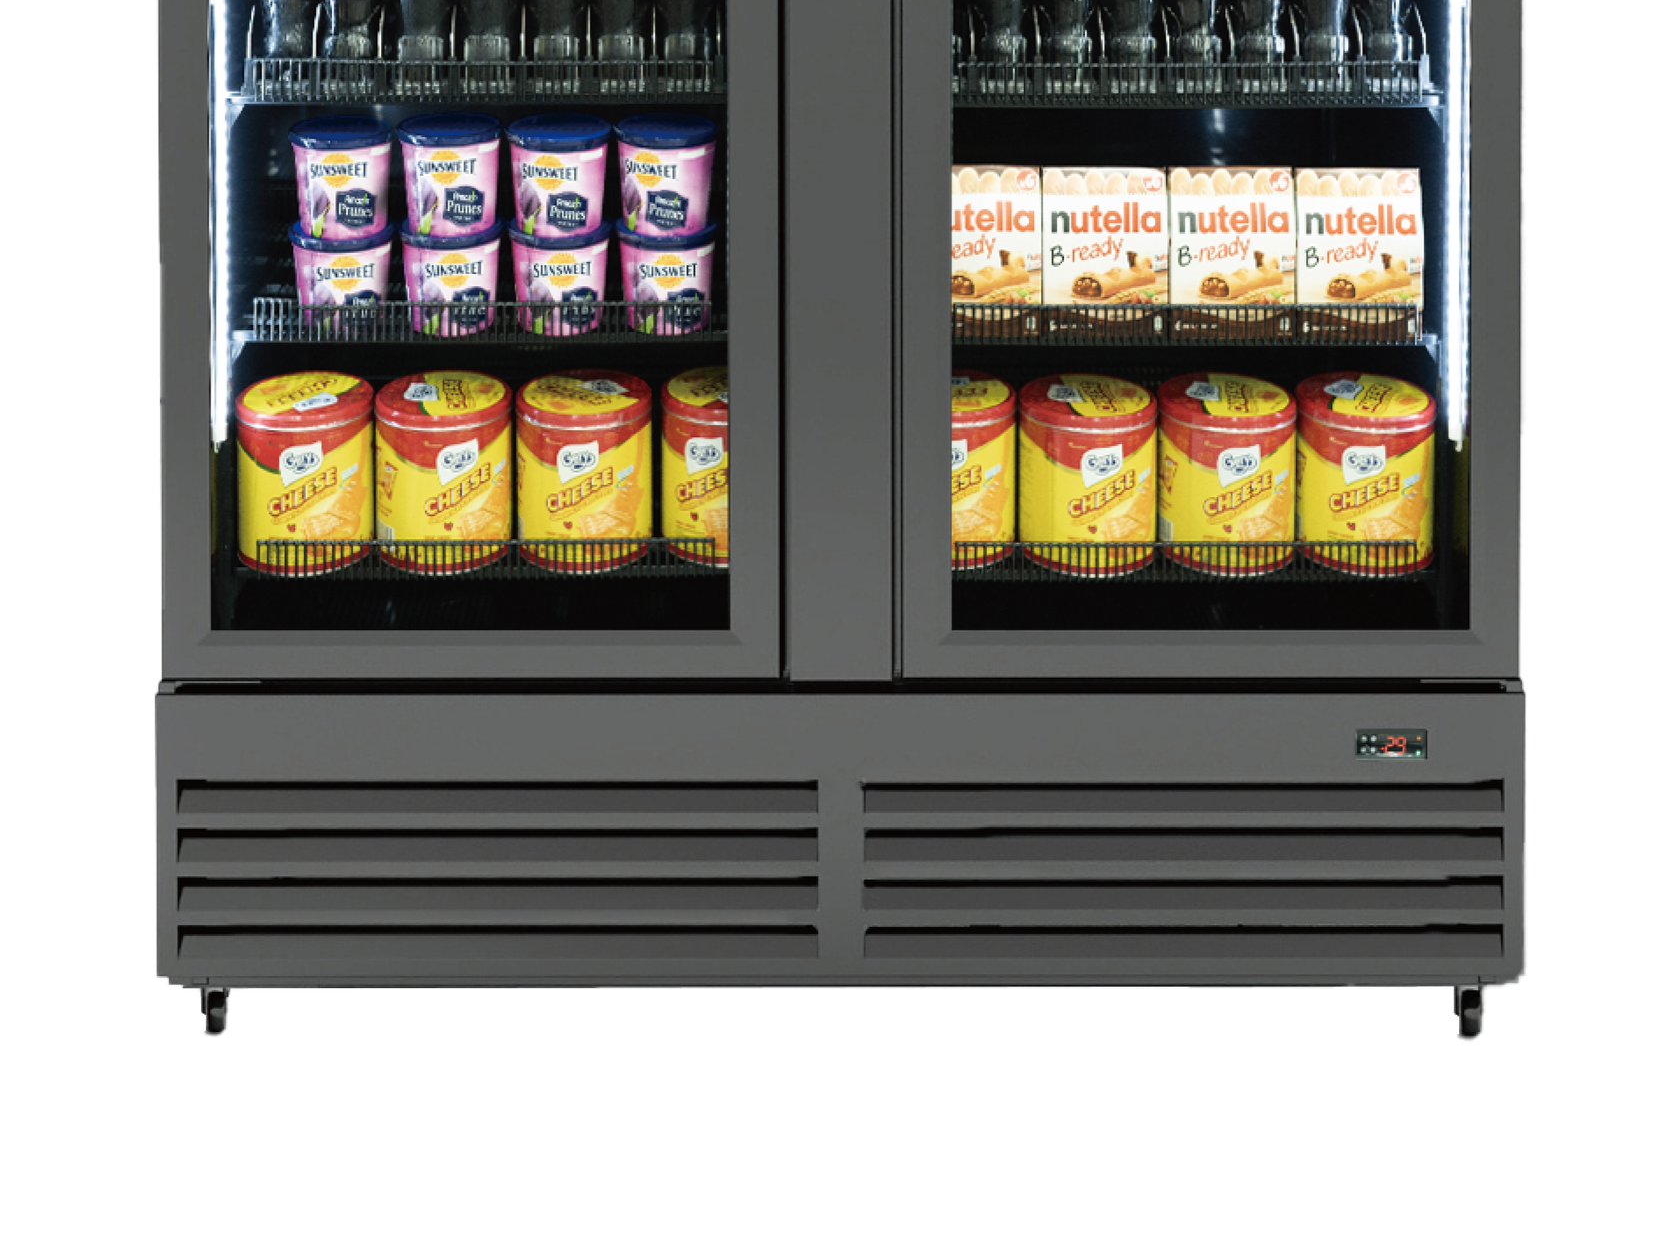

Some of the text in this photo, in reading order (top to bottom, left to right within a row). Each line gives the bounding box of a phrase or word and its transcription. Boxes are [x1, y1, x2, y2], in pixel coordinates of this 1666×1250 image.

[310, 161, 367, 179] SUNSWEET
[417, 157, 477, 176] SUNSWEET
[522, 162, 578, 181] SUNSWEET
[624, 157, 678, 180] SUNSWEET
[338, 202, 373, 217] Prunes
[446, 200, 482, 214] Prunes
[549, 205, 586, 220] Prunes
[649, 204, 684, 220] Prunes
[1051, 202, 1162, 234] nutella
[1178, 202, 1290, 234] nutella
[1305, 203, 1417, 235] nutella
[316, 262, 375, 281] SUNSWEET
[424, 260, 483, 278] SUNSWEET
[533, 261, 592, 278] SUNSWEET
[639, 263, 698, 279] SUNSWEET
[268, 466, 337, 517] CHEESE
[424, 462, 491, 517] CHEESE
[546, 466, 614, 514] CHEESE
[1068, 468, 1135, 518] CHEESE
[1204, 470, 1272, 517] CHEESE
[1328, 472, 1400, 513] CHEESE
